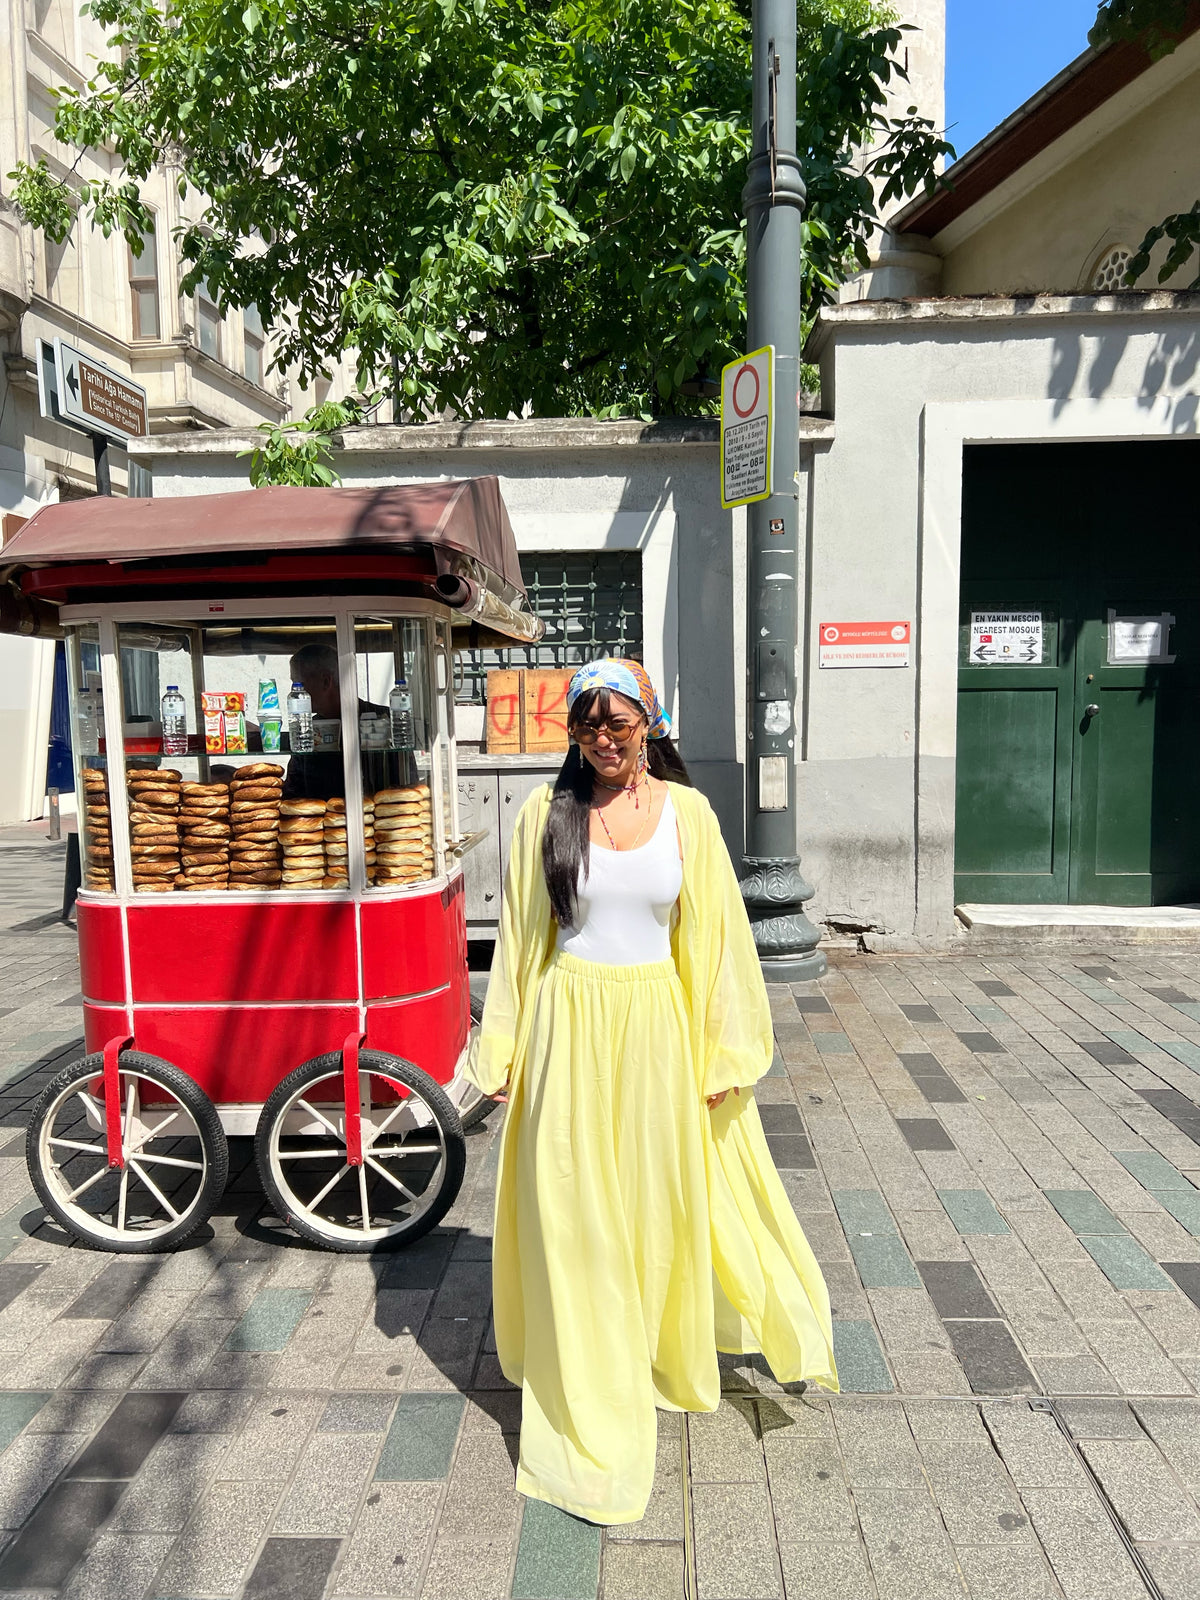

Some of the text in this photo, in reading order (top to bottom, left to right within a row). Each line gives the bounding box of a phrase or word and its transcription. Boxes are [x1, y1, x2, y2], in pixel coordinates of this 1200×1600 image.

[82, 366, 143, 410] Tarihi Ağa Hamamı
[92, 401, 105, 415] Since
[105, 407, 114, 420] The
[112, 401, 129, 416] Turkish
[749, 421, 760, 430] Tarih
[730, 471, 747, 481] Saatleri
[975, 614, 985, 622] EN
[987, 614, 1010, 623] YAKIN
[973, 626, 1040, 634] NEAREST MOSQUE
